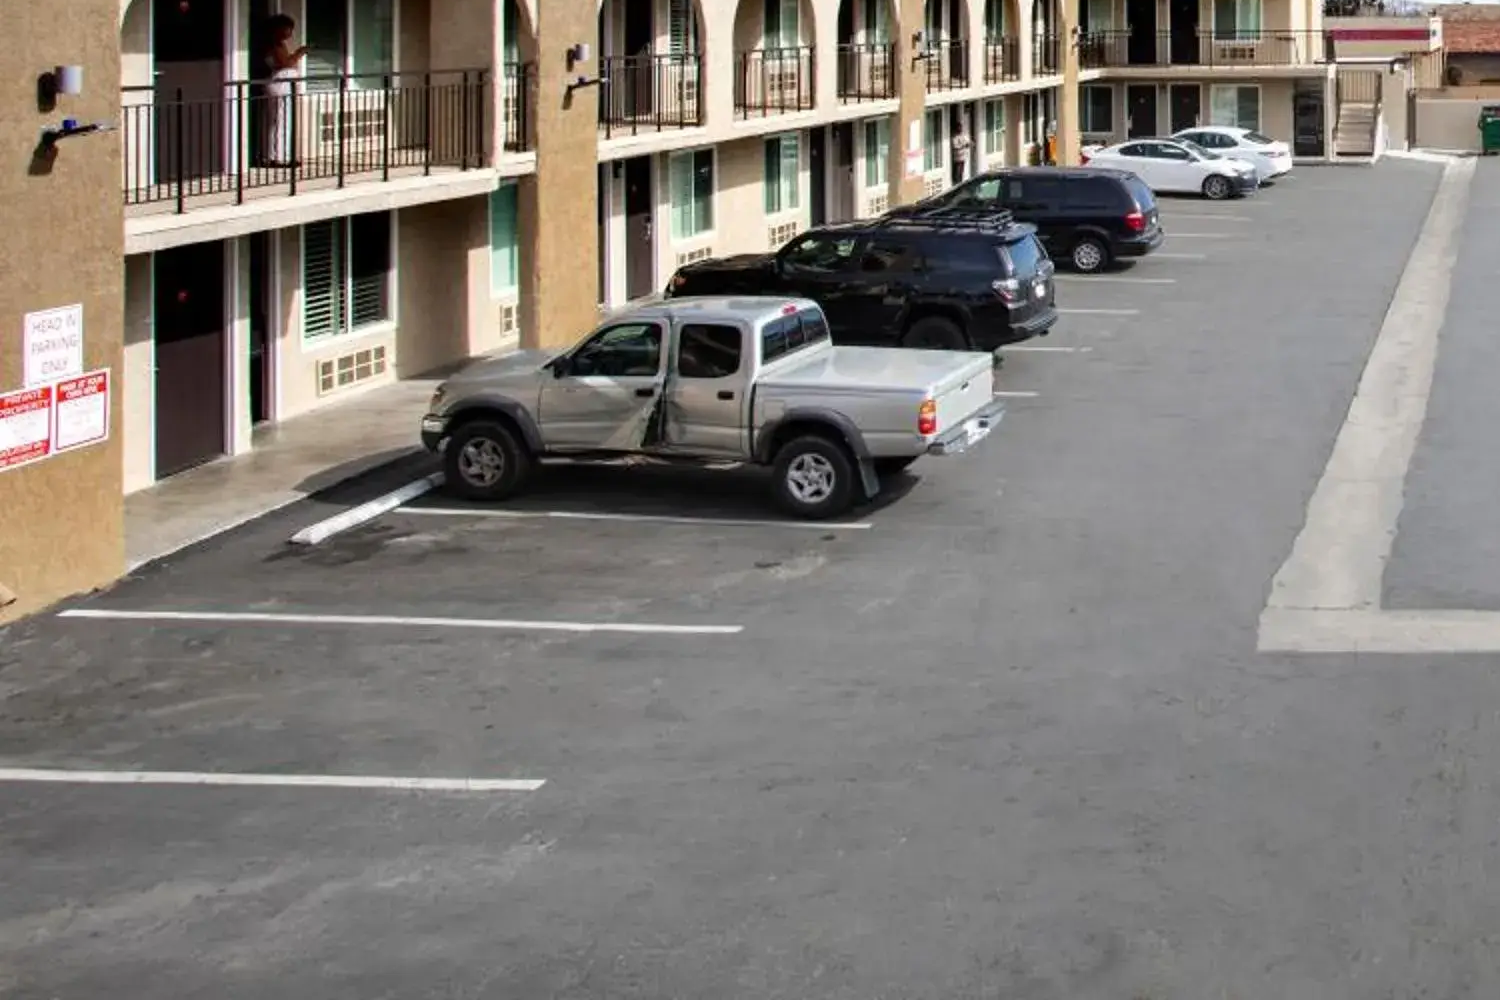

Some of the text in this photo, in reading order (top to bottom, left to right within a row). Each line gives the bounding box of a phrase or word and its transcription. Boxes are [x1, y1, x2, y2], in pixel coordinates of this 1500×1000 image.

[32, 313, 76, 333] HEAD IN
[31, 334, 78, 355] PARKING
[41, 356, 69, 374] ONLY
